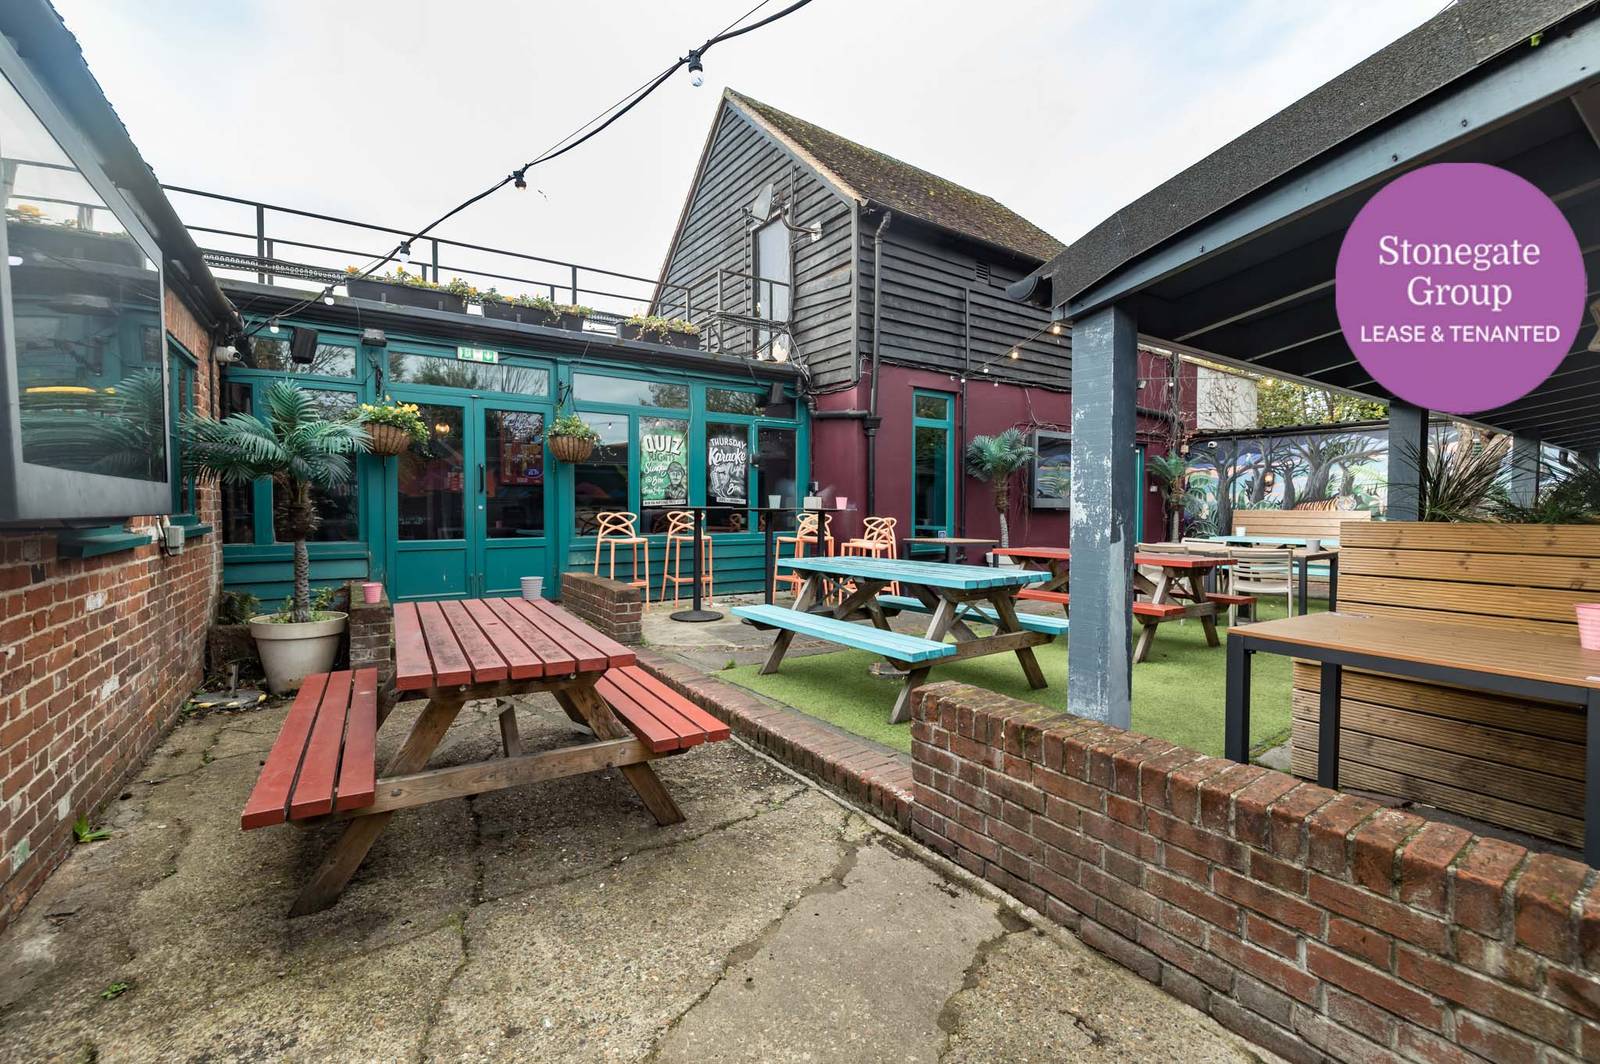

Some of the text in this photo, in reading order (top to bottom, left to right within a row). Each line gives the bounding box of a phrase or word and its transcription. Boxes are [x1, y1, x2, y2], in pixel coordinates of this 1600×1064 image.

[643, 434, 683, 455] QUIZ
[710, 438, 747, 449] THURSDAY
[709, 447, 746, 466] Karaoke
